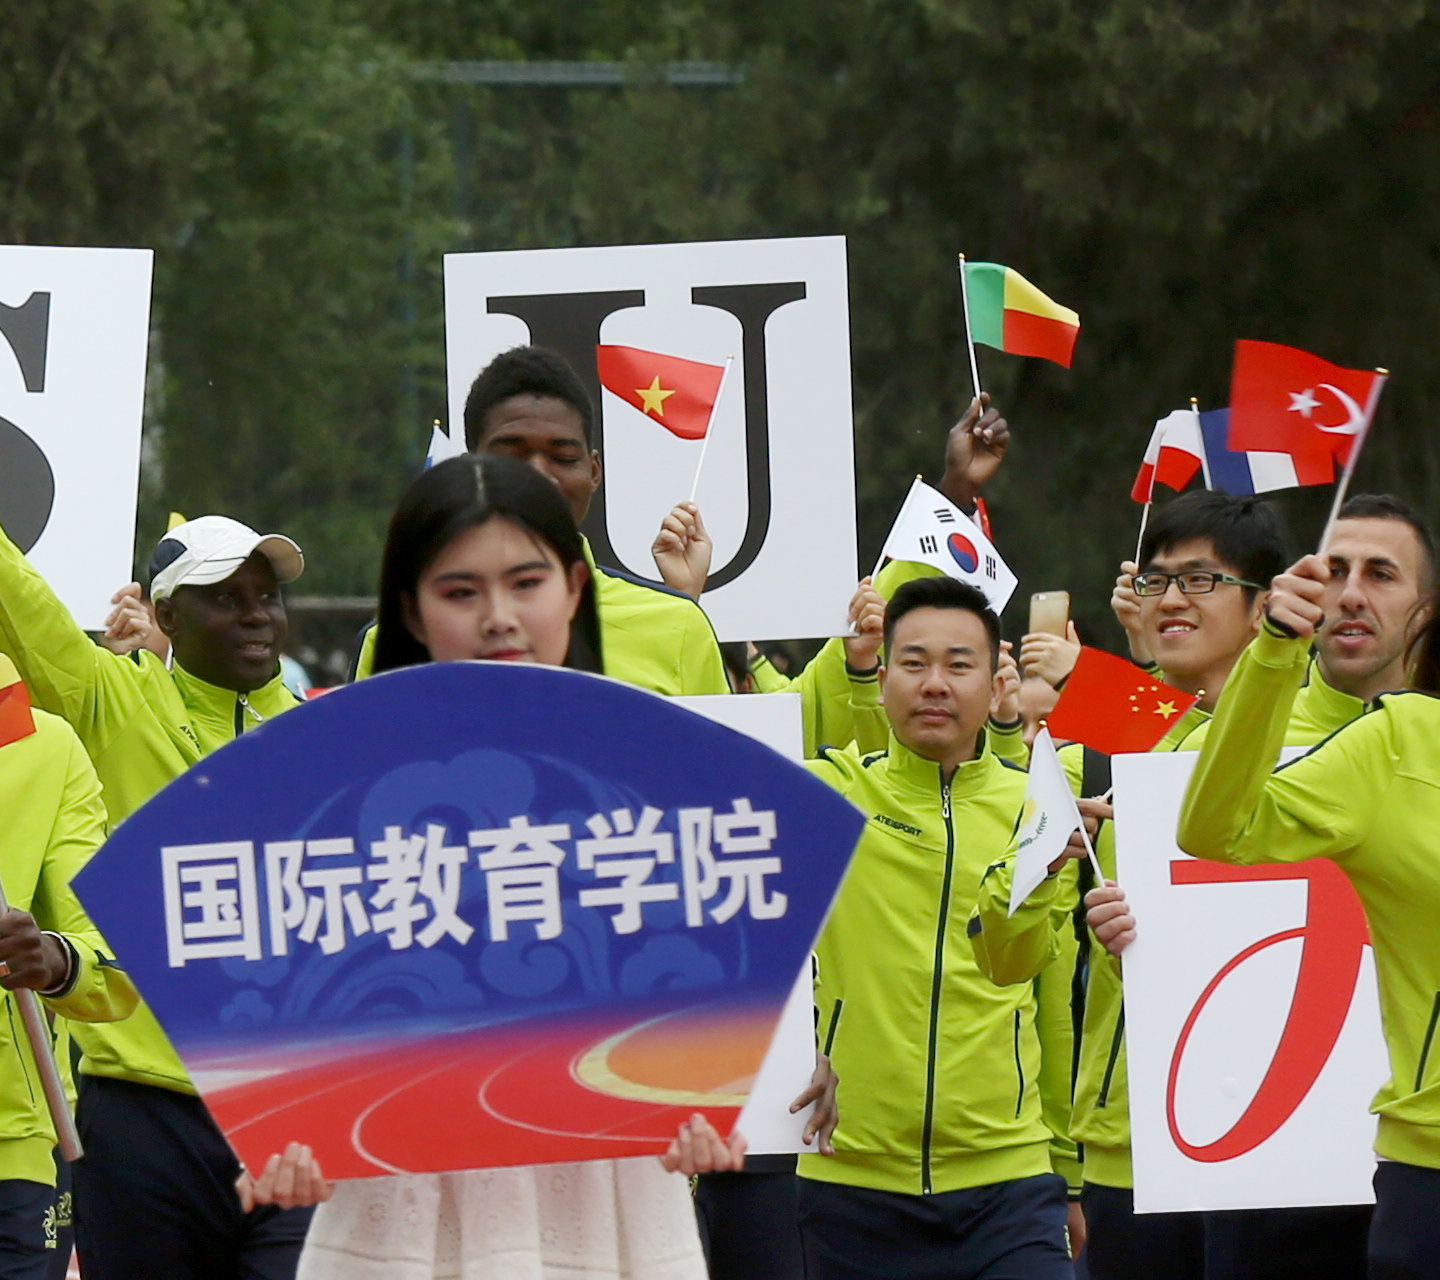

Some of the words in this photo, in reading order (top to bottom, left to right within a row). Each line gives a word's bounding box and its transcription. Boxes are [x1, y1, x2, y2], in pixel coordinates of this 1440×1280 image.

[486, 281, 807, 594] U
[160, 797, 788, 969] 国际教育学院
